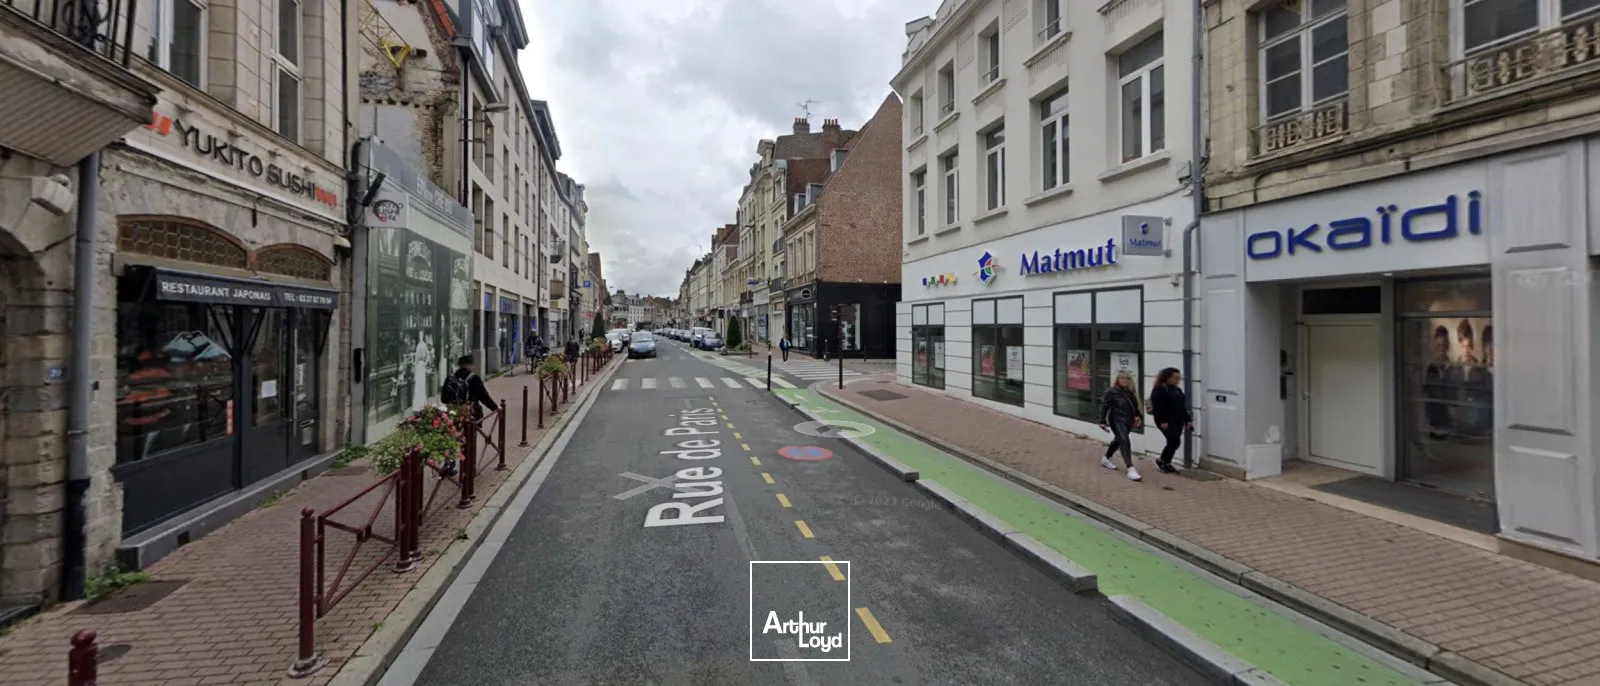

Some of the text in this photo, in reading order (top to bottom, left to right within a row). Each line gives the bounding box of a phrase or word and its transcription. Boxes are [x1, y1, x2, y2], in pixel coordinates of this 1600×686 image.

[174, 119, 315, 200] YUKITO SUSHI
[1020, 238, 1116, 275] Matmut
[1129, 238, 1162, 248] Matmut
[161, 281, 230, 297] RESTAURANT
[233, 289, 271, 301] JAPONAIS
